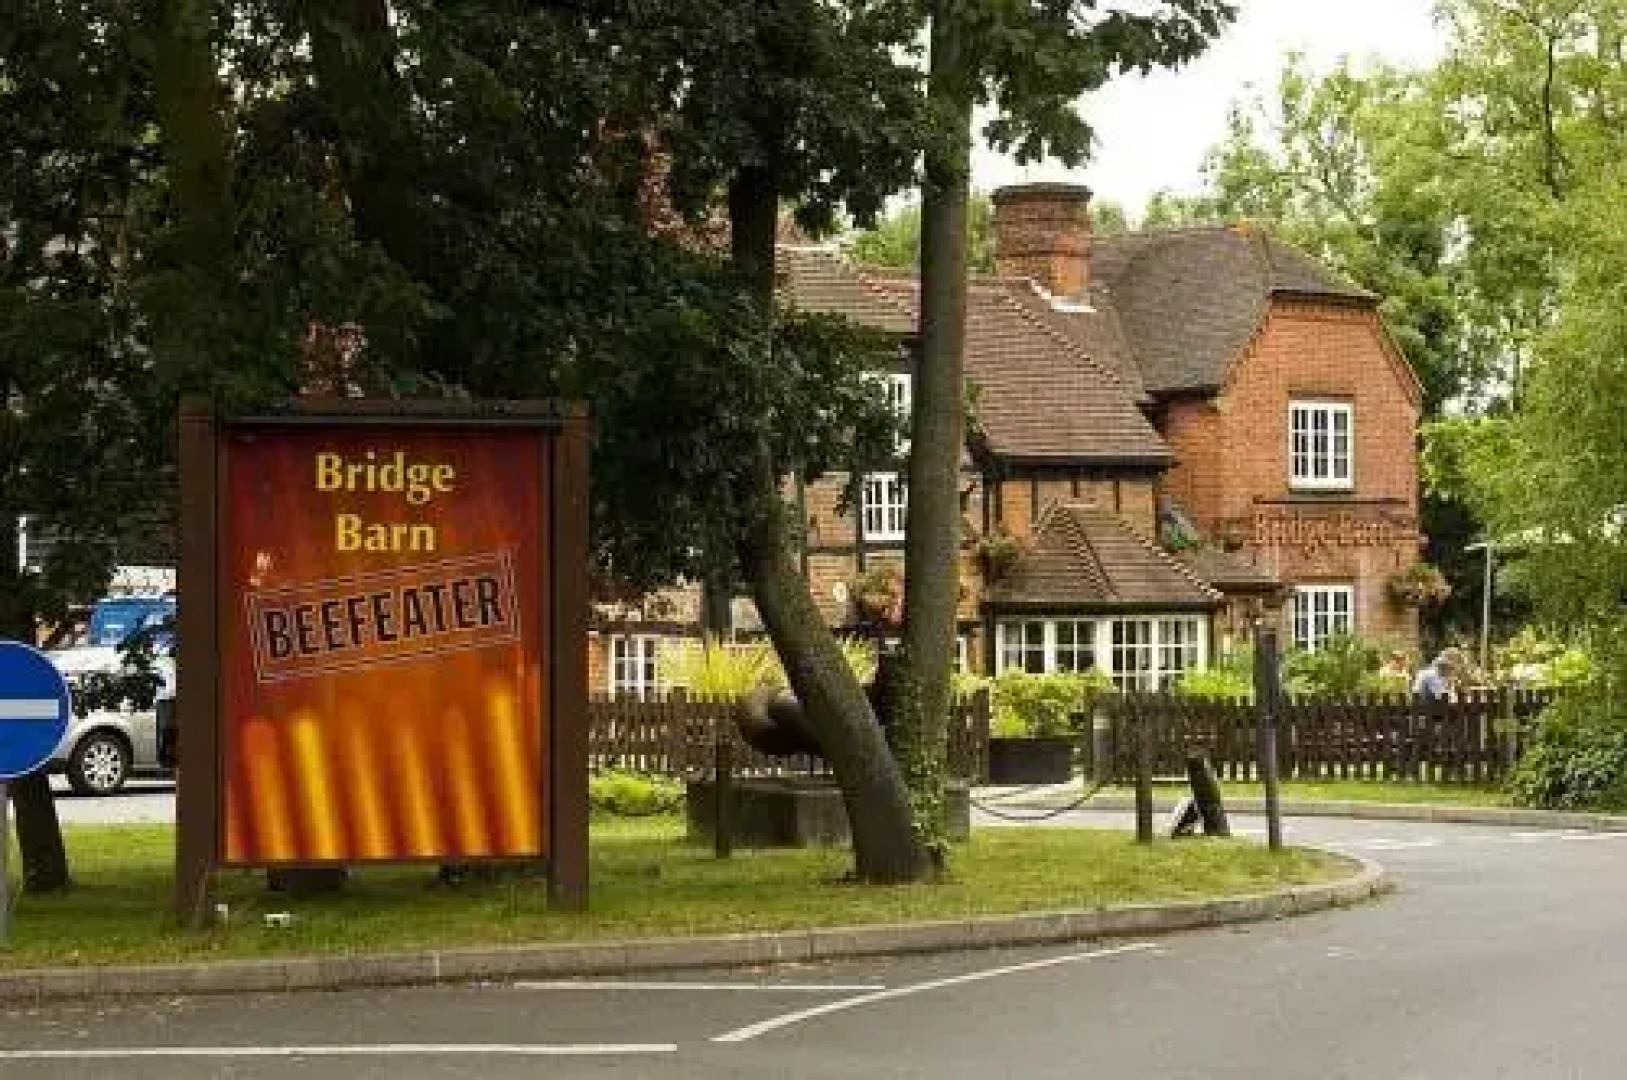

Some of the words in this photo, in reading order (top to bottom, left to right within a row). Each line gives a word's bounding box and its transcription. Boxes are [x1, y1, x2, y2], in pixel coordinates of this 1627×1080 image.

[315, 451, 456, 504] Bridge
[335, 513, 435, 551] Barn
[264, 576, 504, 659] BEEFEATER
